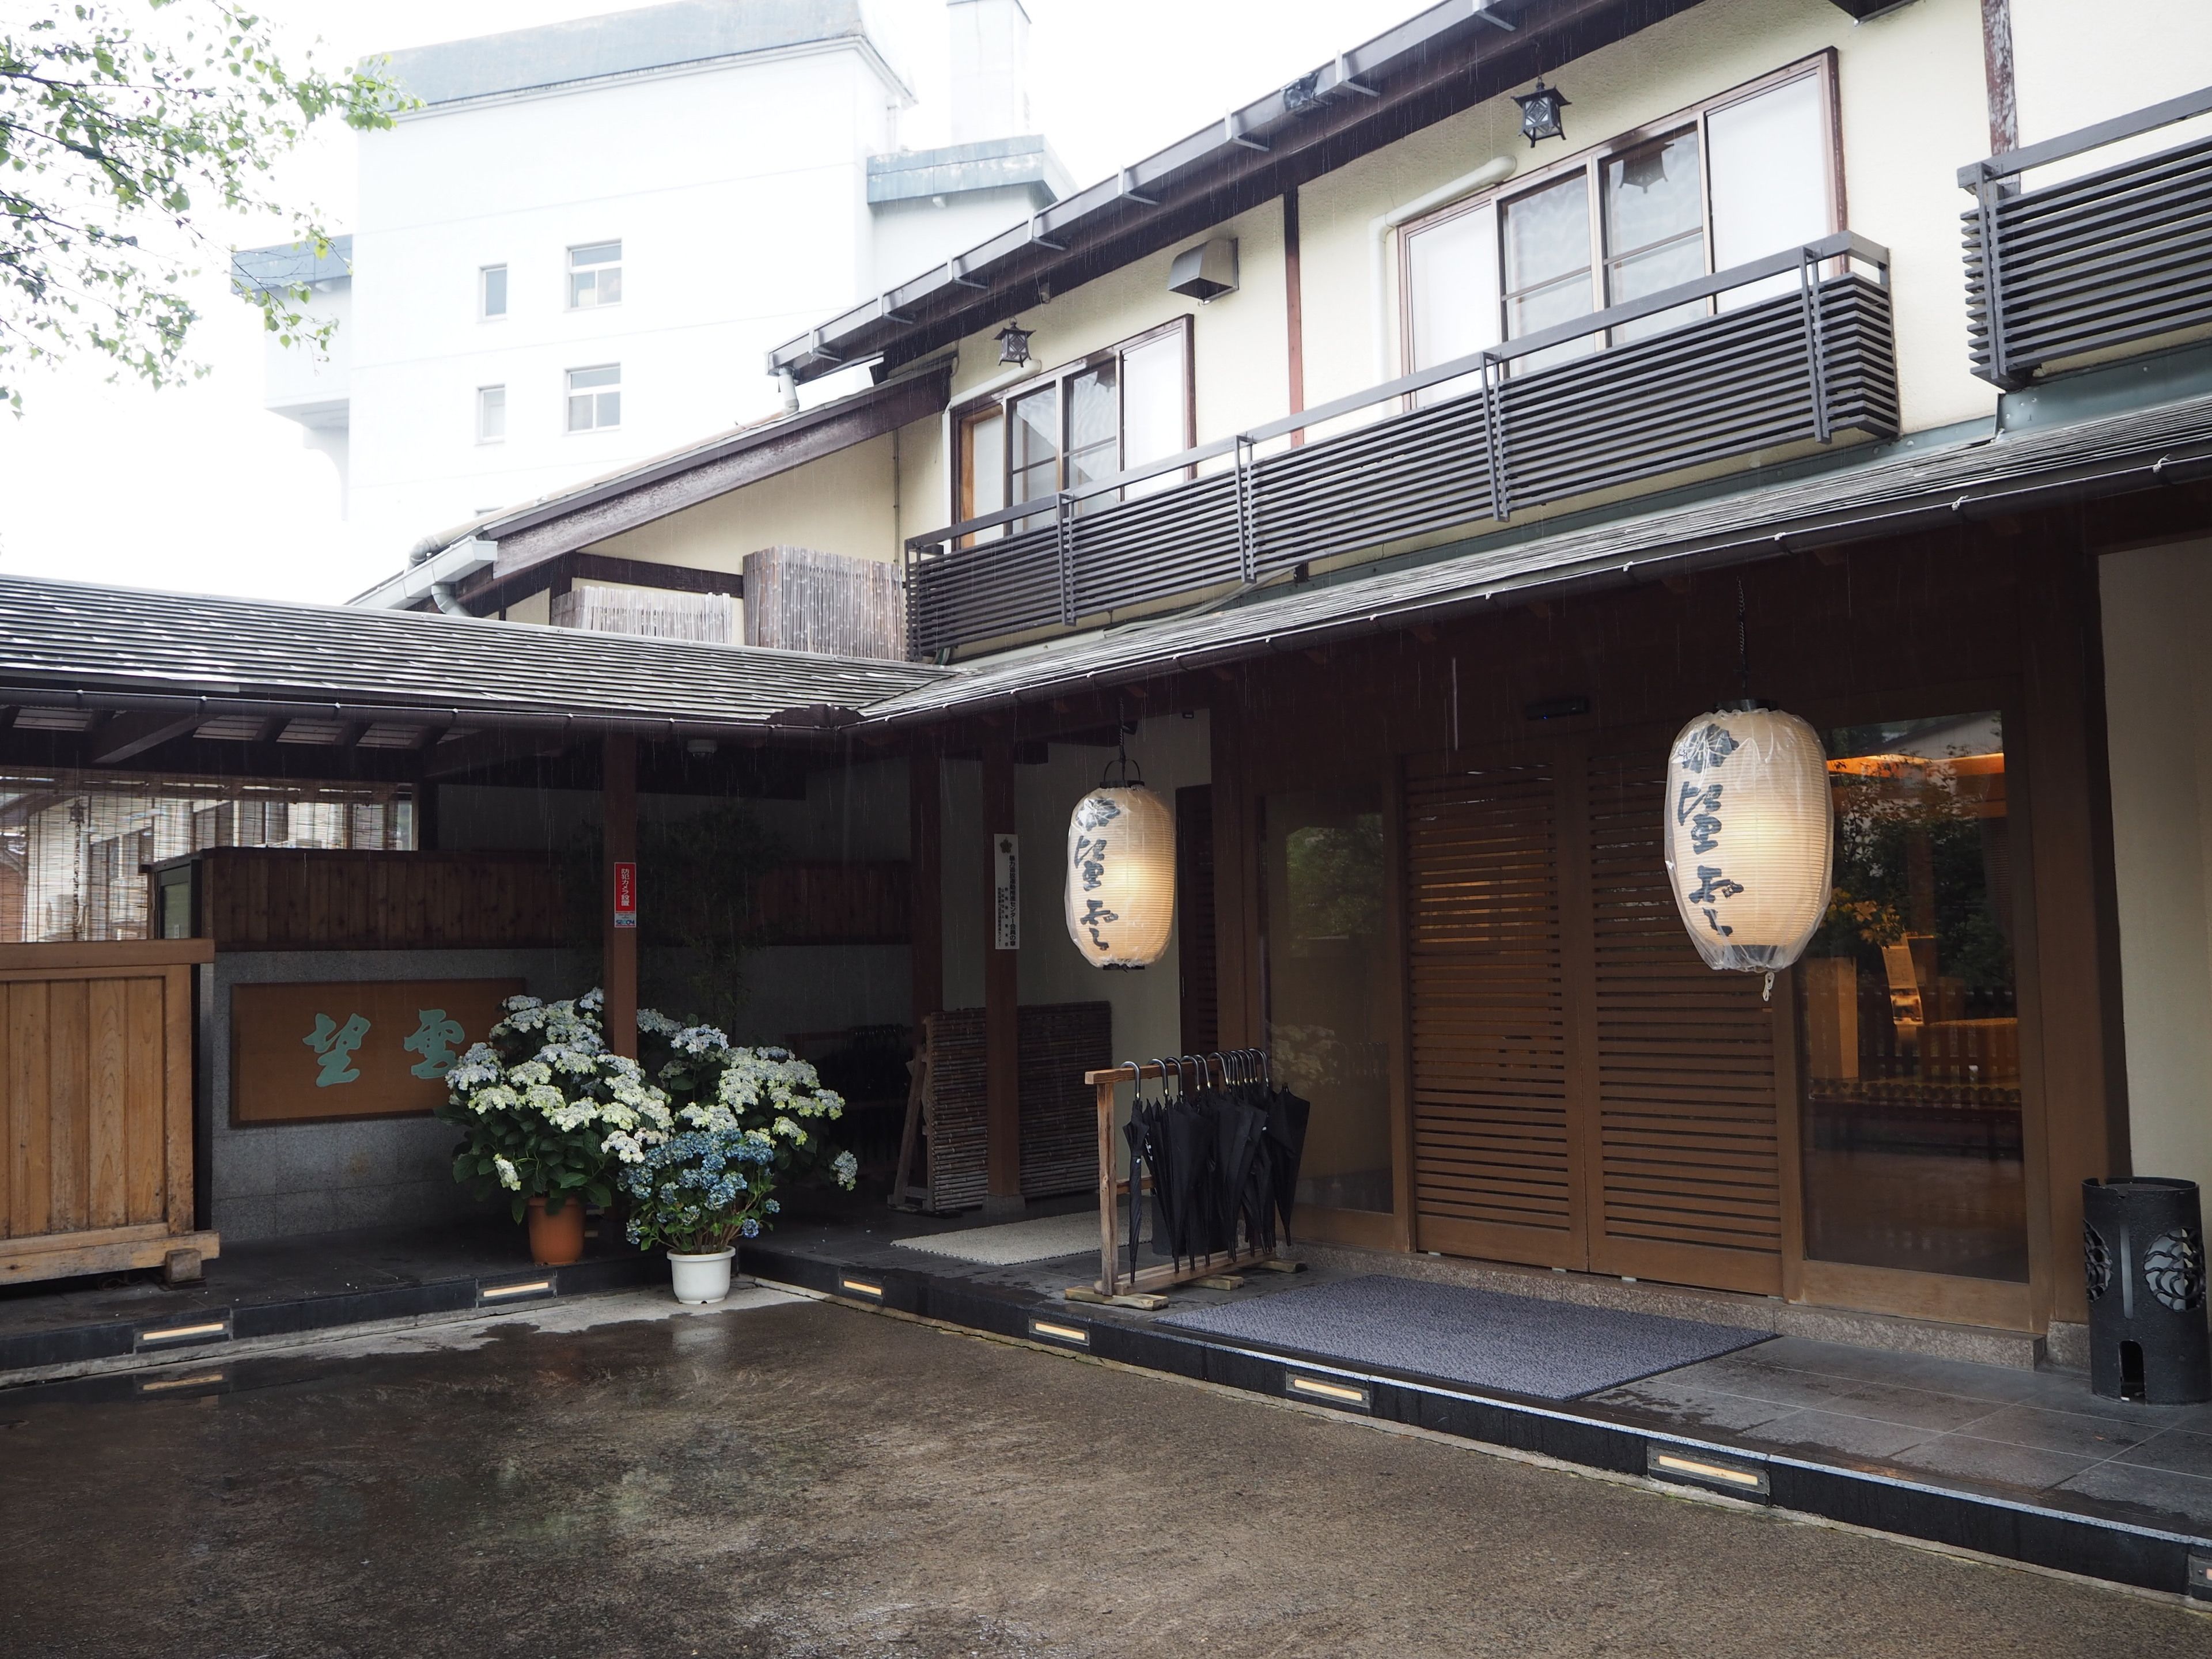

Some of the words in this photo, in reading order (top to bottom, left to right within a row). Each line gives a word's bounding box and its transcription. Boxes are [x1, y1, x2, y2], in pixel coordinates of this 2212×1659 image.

[621, 868, 630, 906] 防犯カメラ設置
